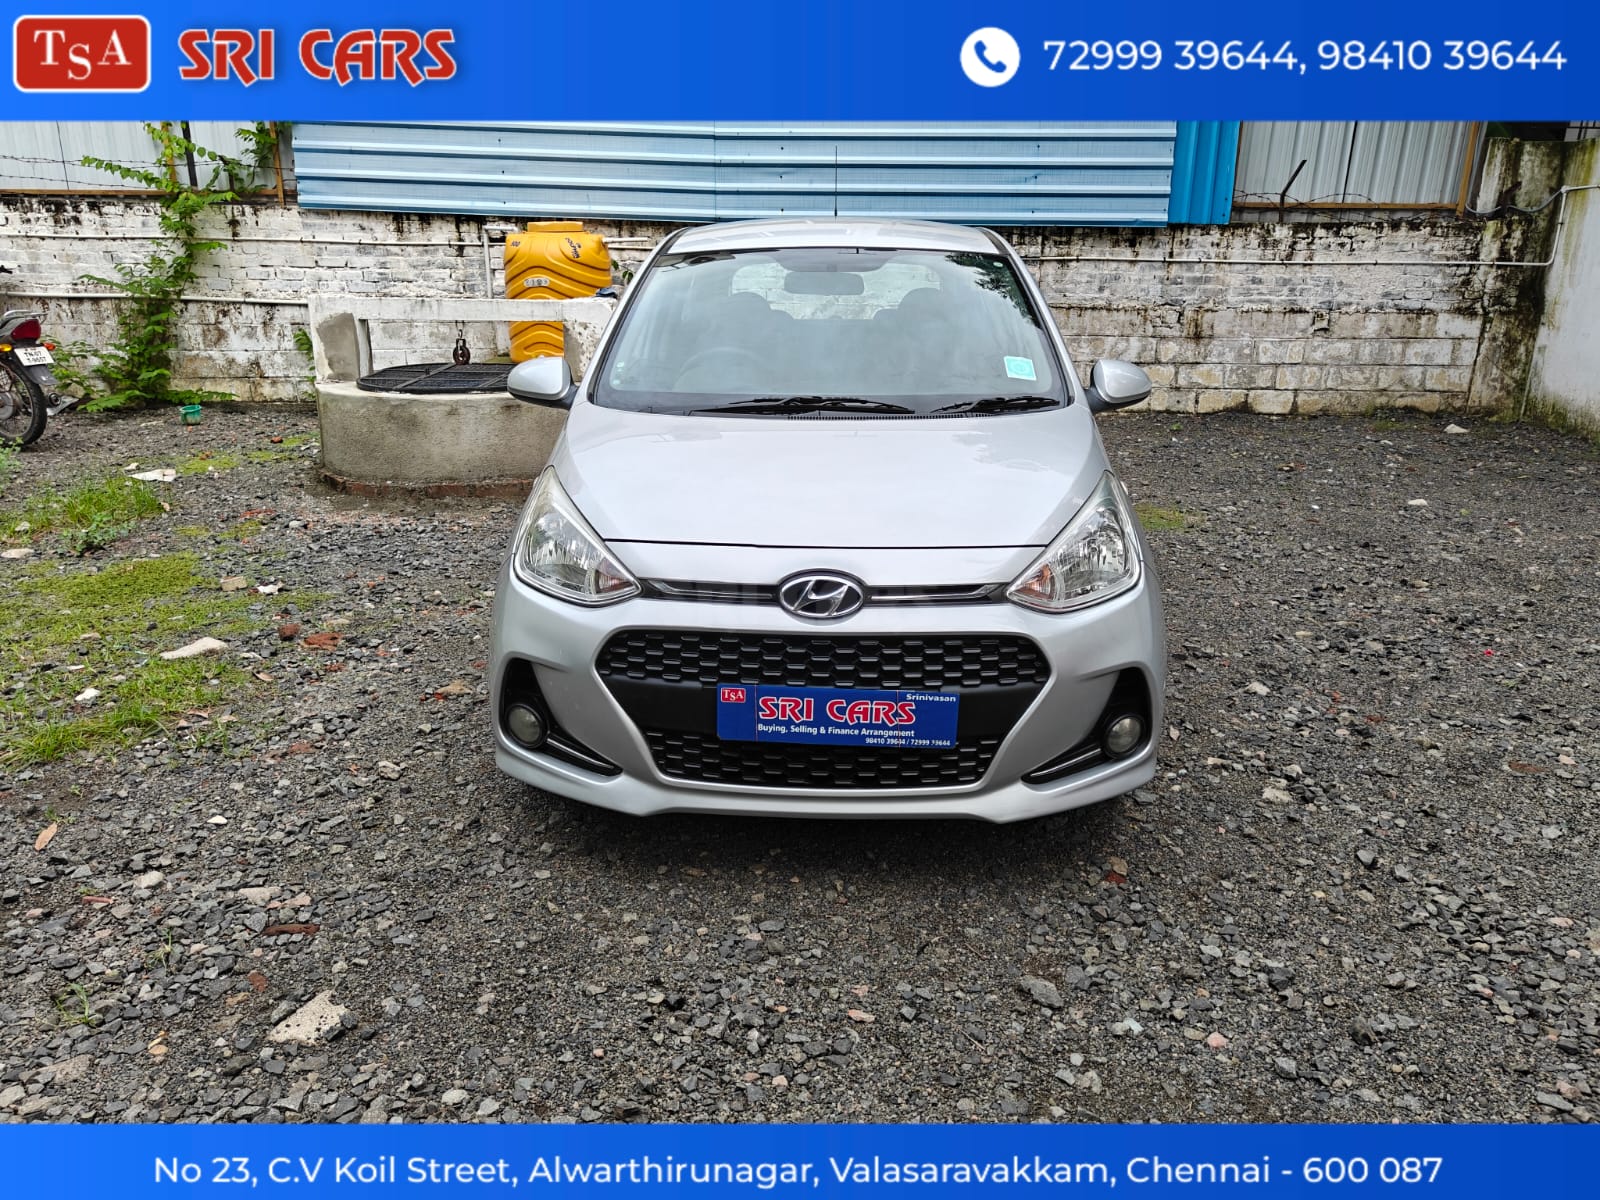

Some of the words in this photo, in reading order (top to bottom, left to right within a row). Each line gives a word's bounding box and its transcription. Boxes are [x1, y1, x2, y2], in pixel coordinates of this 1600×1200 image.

[906, 693, 956, 702] Srinivasan
[759, 696, 814, 723] SRI
[826, 699, 916, 727] CARS
[790, 725, 818, 735] Selling
[819, 726, 826, 734] &
[828, 726, 859, 735] Finance
[860, 728, 915, 738] Arrangement
[865, 737, 885, 745] 98410
